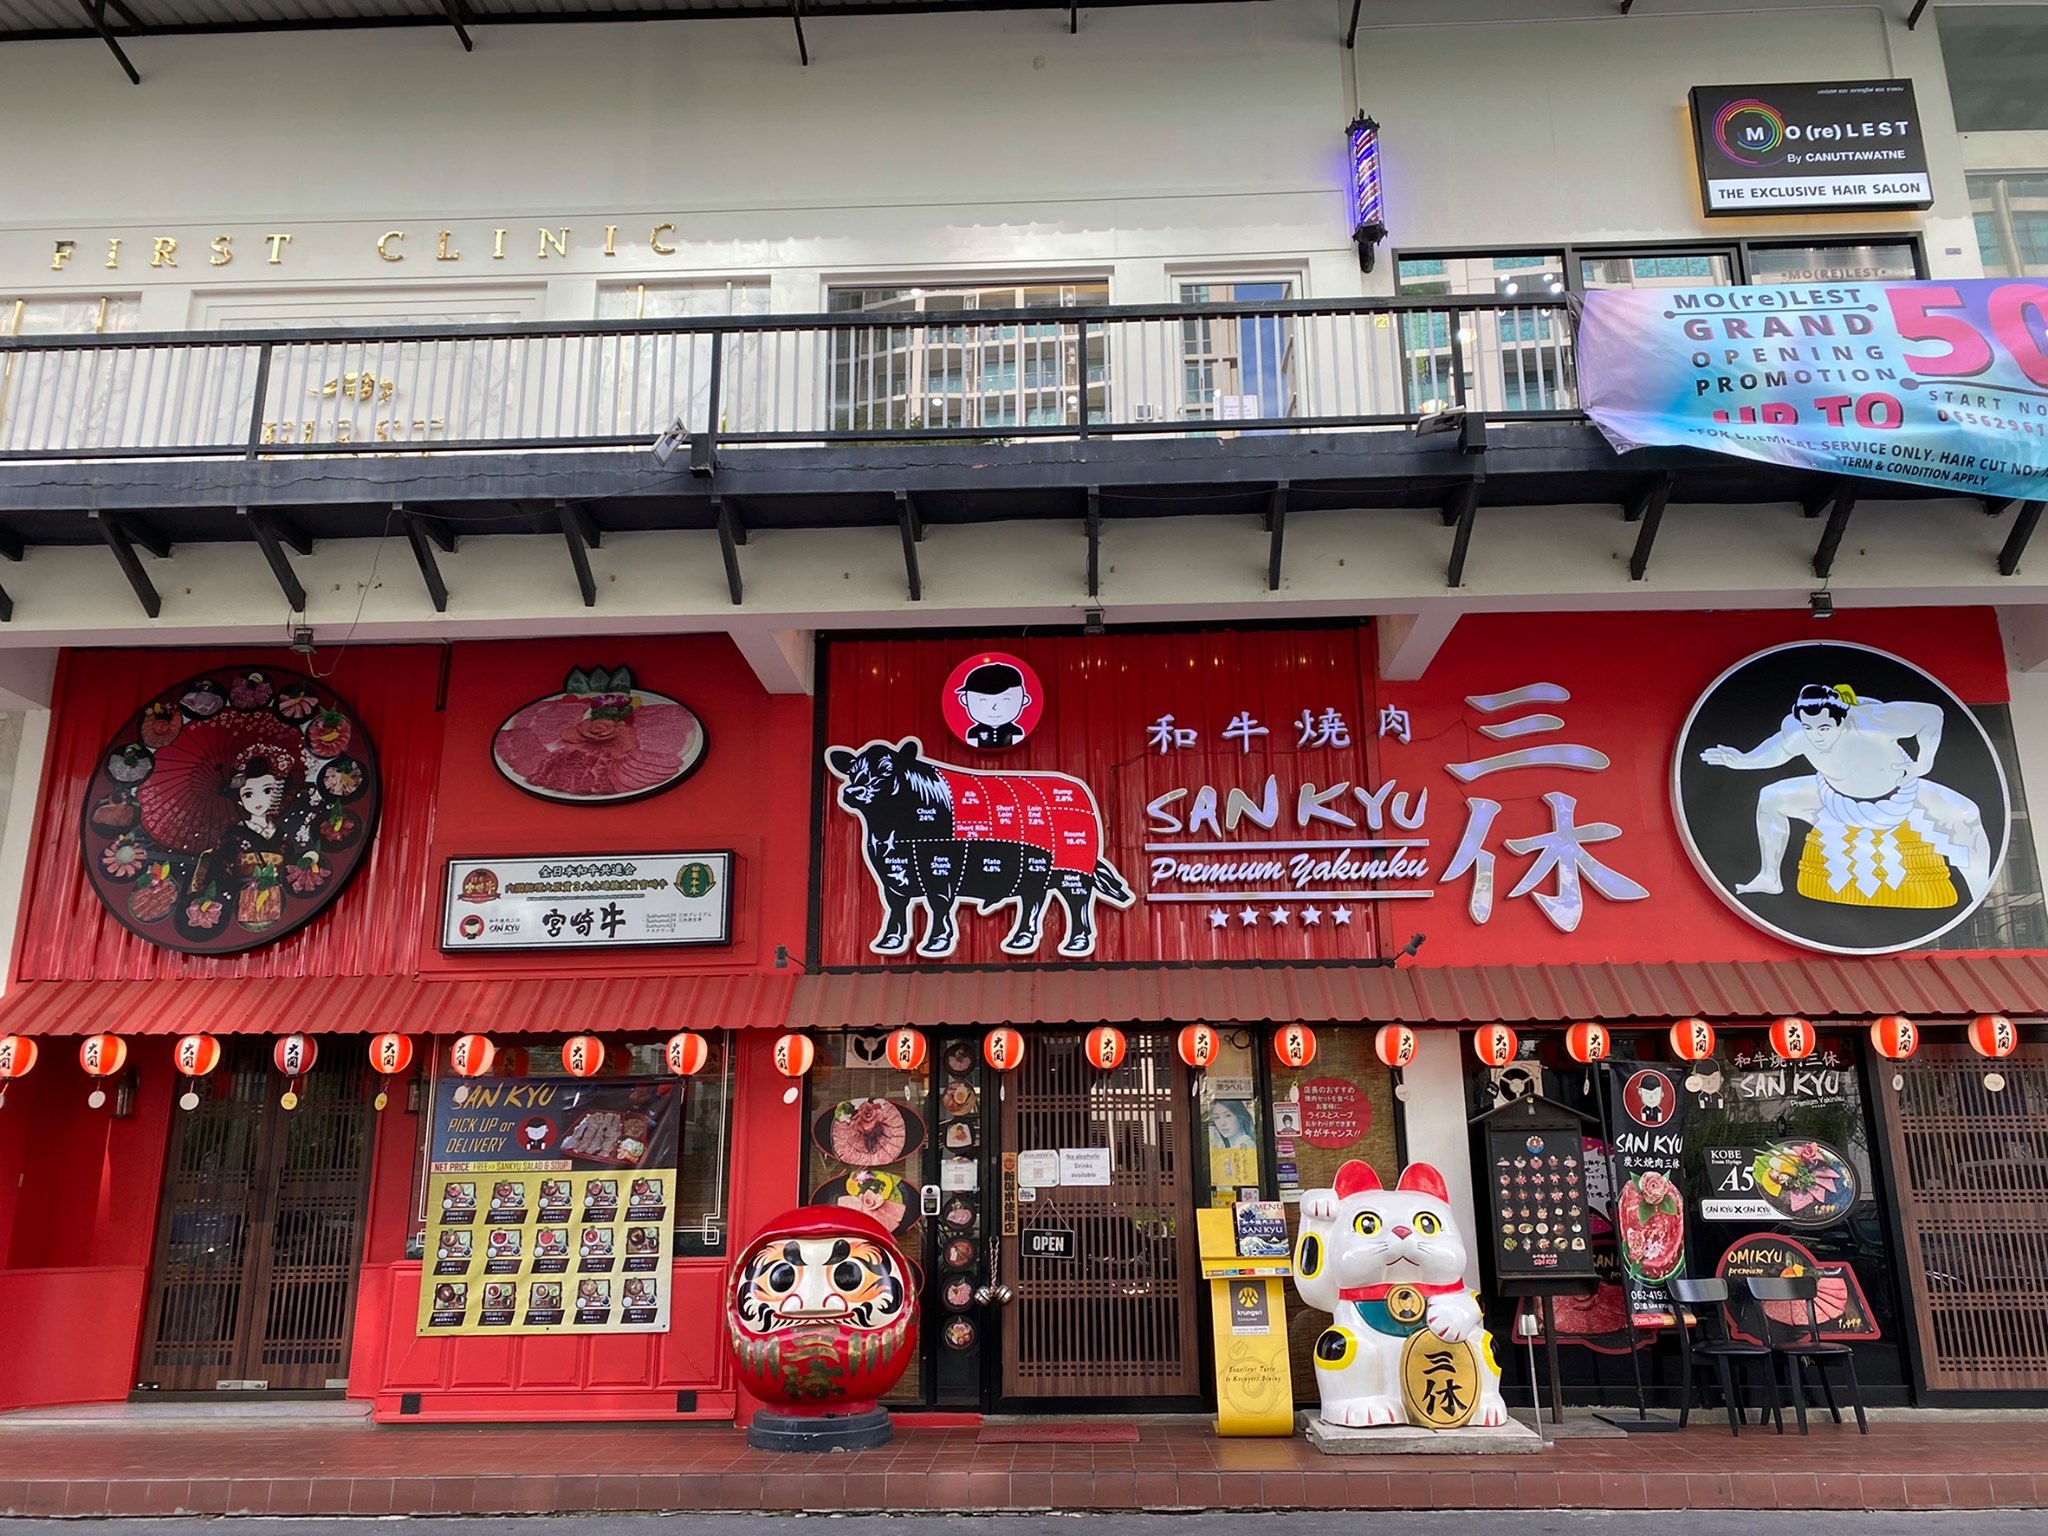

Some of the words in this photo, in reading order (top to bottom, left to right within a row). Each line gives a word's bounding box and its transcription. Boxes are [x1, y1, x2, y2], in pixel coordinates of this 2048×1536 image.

[1787, 153, 1803, 164] By
[1805, 150, 1906, 163] CANUTTAWATNE
[1719, 188, 1745, 199] THE
[1750, 185, 1827, 198] EXCLUSIVE
[1832, 184, 1867, 196] HAIR
[1873, 182, 1921, 195] SALON
[50, 233, 292, 270] FIRST
[377, 223, 679, 263] CLINIC
[1673, 289, 1861, 310] MO(re)LEST
[1683, 313, 1875, 341] GRAND
[1692, 345, 1885, 368] OPENING
[1695, 367, 1897, 396] PROMOTION
[1929, 390, 2002, 410] START
[1814, 392, 1904, 430] TO
[1821, 440, 1887, 455] SERVICE
[1891, 445, 1935, 463] ONLY.
[1939, 452, 1975, 469] HAIR
[1980, 457, 2008, 473] CUT
[1875, 462, 1885, 472] &
[1887, 462, 1951, 481] CONDITION
[1951, 473, 1990, 487] APPLY
[1147, 775, 1280, 840] SAN
[1297, 779, 1428, 831] KYU
[1438, 682, 1651, 934] 三休
[1151, 856, 1286, 887] Premium
[1290, 847, 1430, 888] Yakiniku
[542, 902, 627, 938] 宮崎牛
[1734, 1051, 1840, 1069] 和牛焼三休
[1304, 1086, 1355, 1094] 店長のおすすめ
[1741, 1069, 1786, 1098] SAN
[1793, 1069, 1840, 1096] KYU
[504, 1081, 559, 1109] KYU
[1790, 1099, 1818, 1107] Premium
[1818, 1096, 1845, 1105] Yakiniku
[1308, 1111, 1354, 1119] ライスとスープ
[447, 1117, 479, 1132] PICK
[479, 1117, 499, 1133] UP
[499, 1122, 515, 1132] or
[446, 1137, 507, 1153] DELIVERY
[1616, 1131, 1649, 1155] SAN
[1653, 1133, 1684, 1156] KYU
[1623, 1155, 1681, 1169] 炭火焼肉三休
[1711, 1149, 1742, 1160] KOBE
[434, 1163, 450, 1171] NET
[450, 1162, 470, 1171] PRICE
[496, 1162, 522, 1170] SANKYU
[523, 1162, 544, 1170] SALAD
[550, 1161, 569, 1169] SOUP
[1718, 1166, 1755, 1192] A5
[1254, 1203, 1284, 1211] MENU
[1033, 1235, 1065, 1252] OPEN
[1727, 1248, 1783, 1265] OMIKYU
[1728, 1267, 1764, 1277] premium
[1631, 1290, 1669, 1300] 062-4192
[1237, 1309, 1263, 1317] krungsri
[1634, 1316, 1648, 1324] Open
[1421, 1350, 1468, 1417] 三休
